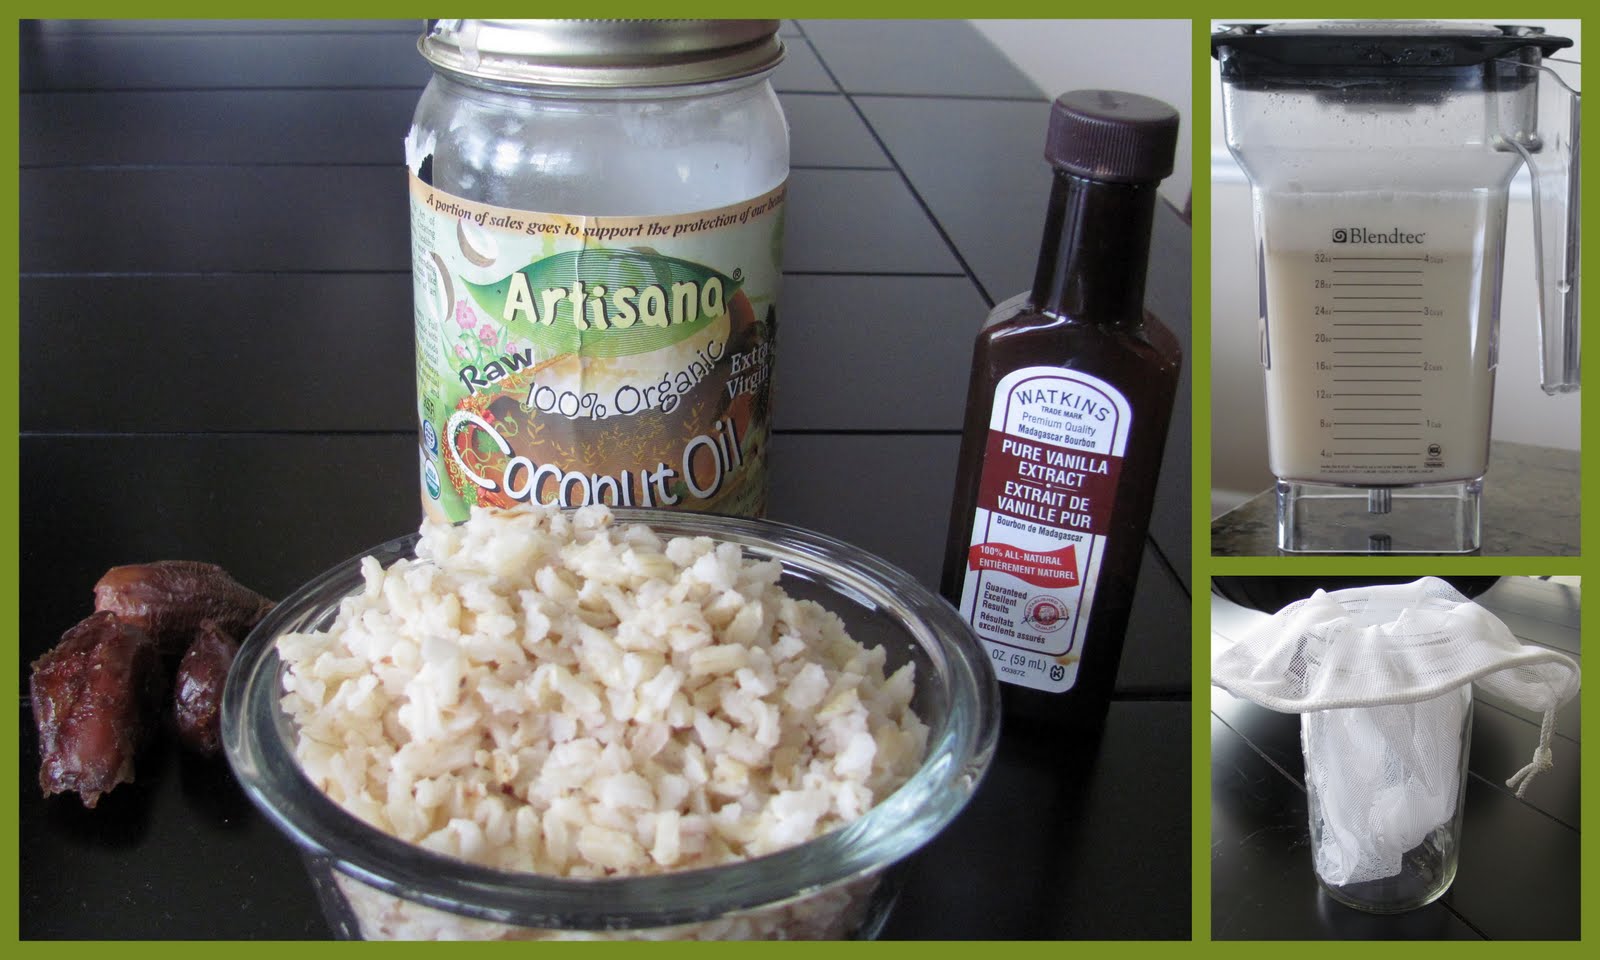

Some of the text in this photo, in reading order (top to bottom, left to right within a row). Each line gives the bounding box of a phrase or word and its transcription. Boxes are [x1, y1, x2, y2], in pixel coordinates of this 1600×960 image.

[426, 193, 434, 206] A
[435, 199, 472, 220] portion
[475, 212, 489, 226] of
[489, 216, 524, 230] sales
[526, 222, 561, 235] goes
[564, 223, 580, 235] to
[583, 223, 643, 240] support
[647, 222, 672, 236] the
[673, 214, 736, 237] protection
[740, 206, 752, 225] of
[751, 202, 767, 218] our
[1350, 228, 1424, 244] Blendtec
[502, 271, 727, 330] Artisana
[459, 348, 533, 397] Raw
[730, 342, 769, 376] Extra
[526, 339, 725, 420] 100% Organic
[726, 364, 769, 400] Virgin
[1016, 389, 1110, 422] WATKINS
[1041, 405, 1083, 420] TRADE MARK
[1018, 424, 1096, 448] Madagascar Bourbon
[1022, 412, 1096, 437] Premium Quality
[447, 409, 745, 507] Coconut Oil
[1002, 439, 1108, 475] PURE VANILLA
[1018, 461, 1086, 488] EXTRACT
[1004, 481, 1090, 512] EXTRAIT DE
[997, 495, 1092, 529] VANILLE PUR
[997, 516, 1083, 543] Bourbon de Madagascar
[979, 558, 1075, 580] ENTIÈREMENT NATUREL
[980, 545, 1062, 566] 100% ALL-NATURAL
[984, 591, 1017, 607] Excellent
[985, 582, 1027, 600] Guaranteed
[980, 611, 1014, 627] Résultats
[982, 600, 1009, 614] Results
[978, 621, 1046, 644] excellents assurés
[992, 648, 1047, 672] OZ. (59 mL)
